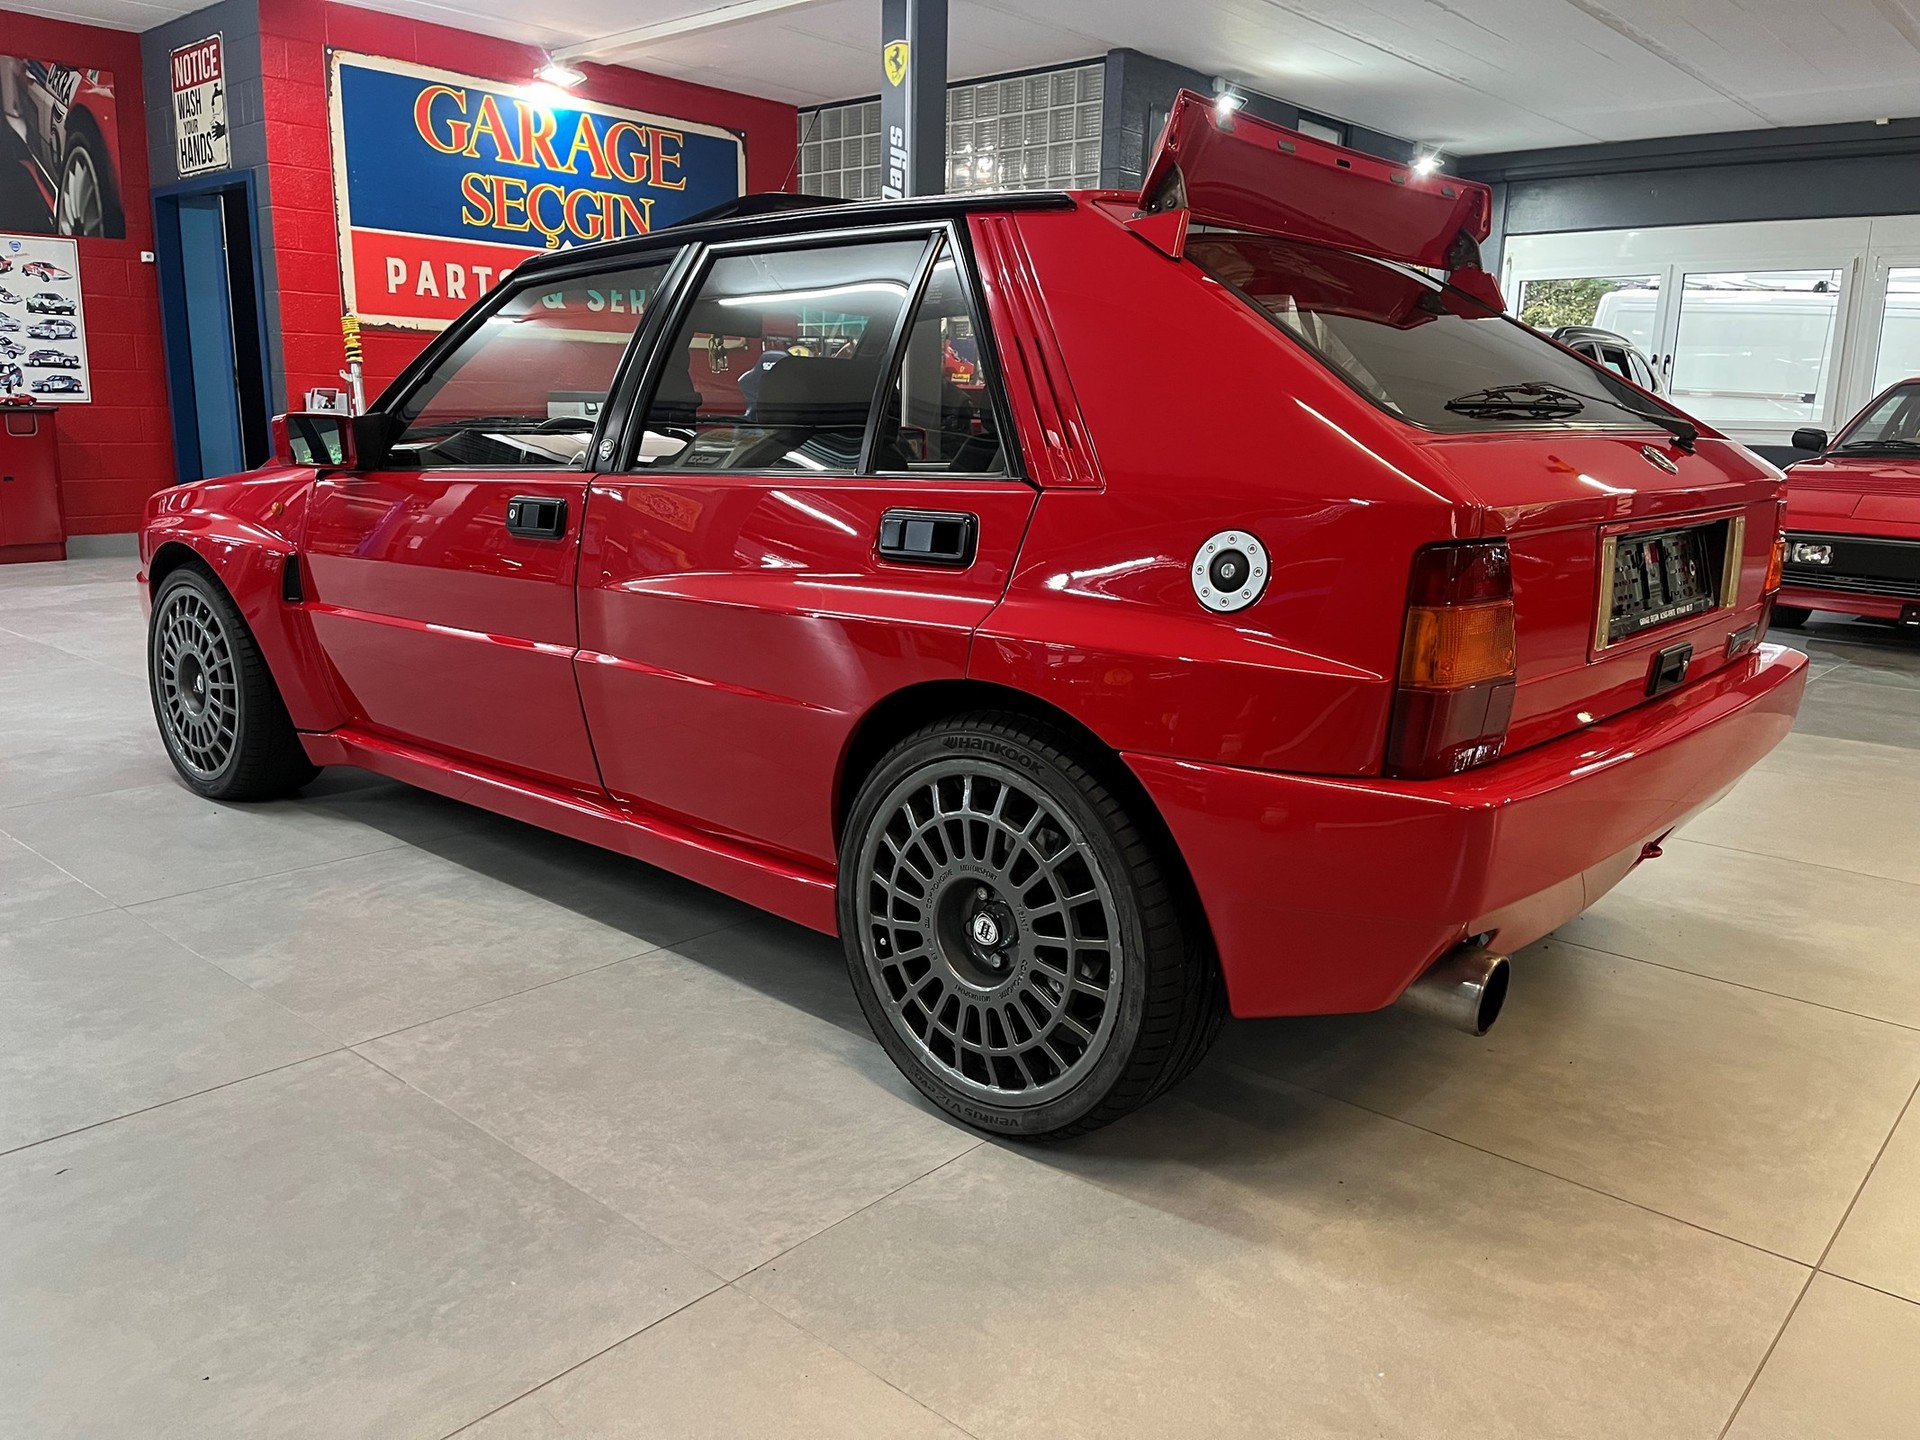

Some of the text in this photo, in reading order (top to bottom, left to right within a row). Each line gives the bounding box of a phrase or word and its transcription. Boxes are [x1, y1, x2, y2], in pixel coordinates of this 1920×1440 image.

[174, 43, 219, 89] NOTICE
[177, 87, 202, 120] WASH
[183, 118, 199, 136] YOUR
[413, 85, 687, 191] GARAGE
[180, 131, 214, 170] HANDS
[461, 171, 655, 249] SEÇGIN
[586, 288, 647, 315] SER
